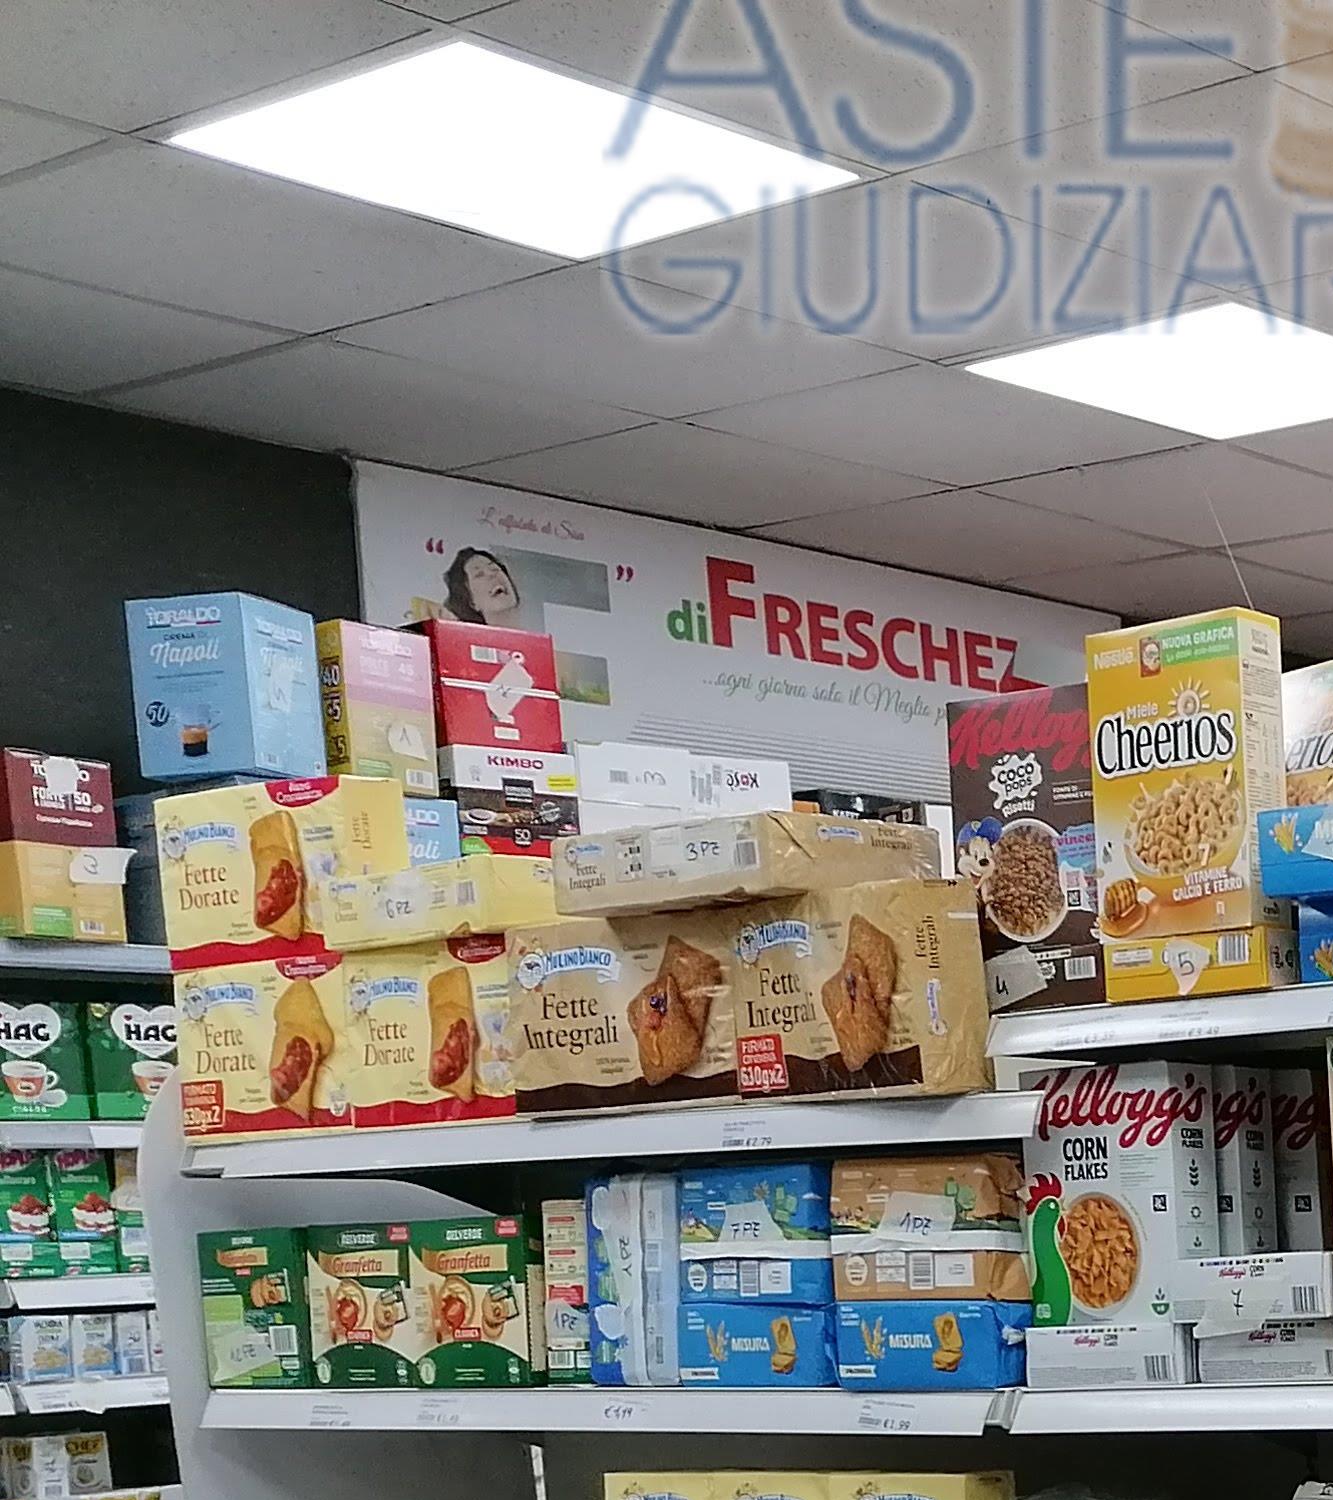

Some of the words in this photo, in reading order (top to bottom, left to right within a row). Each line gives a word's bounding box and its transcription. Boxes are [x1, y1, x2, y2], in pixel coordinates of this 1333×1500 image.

[667, 599, 708, 644] di
[1099, 710, 1235, 777] Cheerios
[487, 755, 543, 770] KIMBO
[185, 863, 226, 885] Fette
[180, 887, 240, 910] Dorate
[745, 998, 817, 1030] Integrali
[124, 1020, 177, 1042] HAG
[204, 1024, 244, 1047] Fette
[369, 1017, 408, 1041] Fette
[524, 1021, 619, 1055] Integrali
[197, 1050, 256, 1074] Dorate
[1062, 1136, 1109, 1162] CORN
[1064, 1162, 1109, 1182] FLAKES
